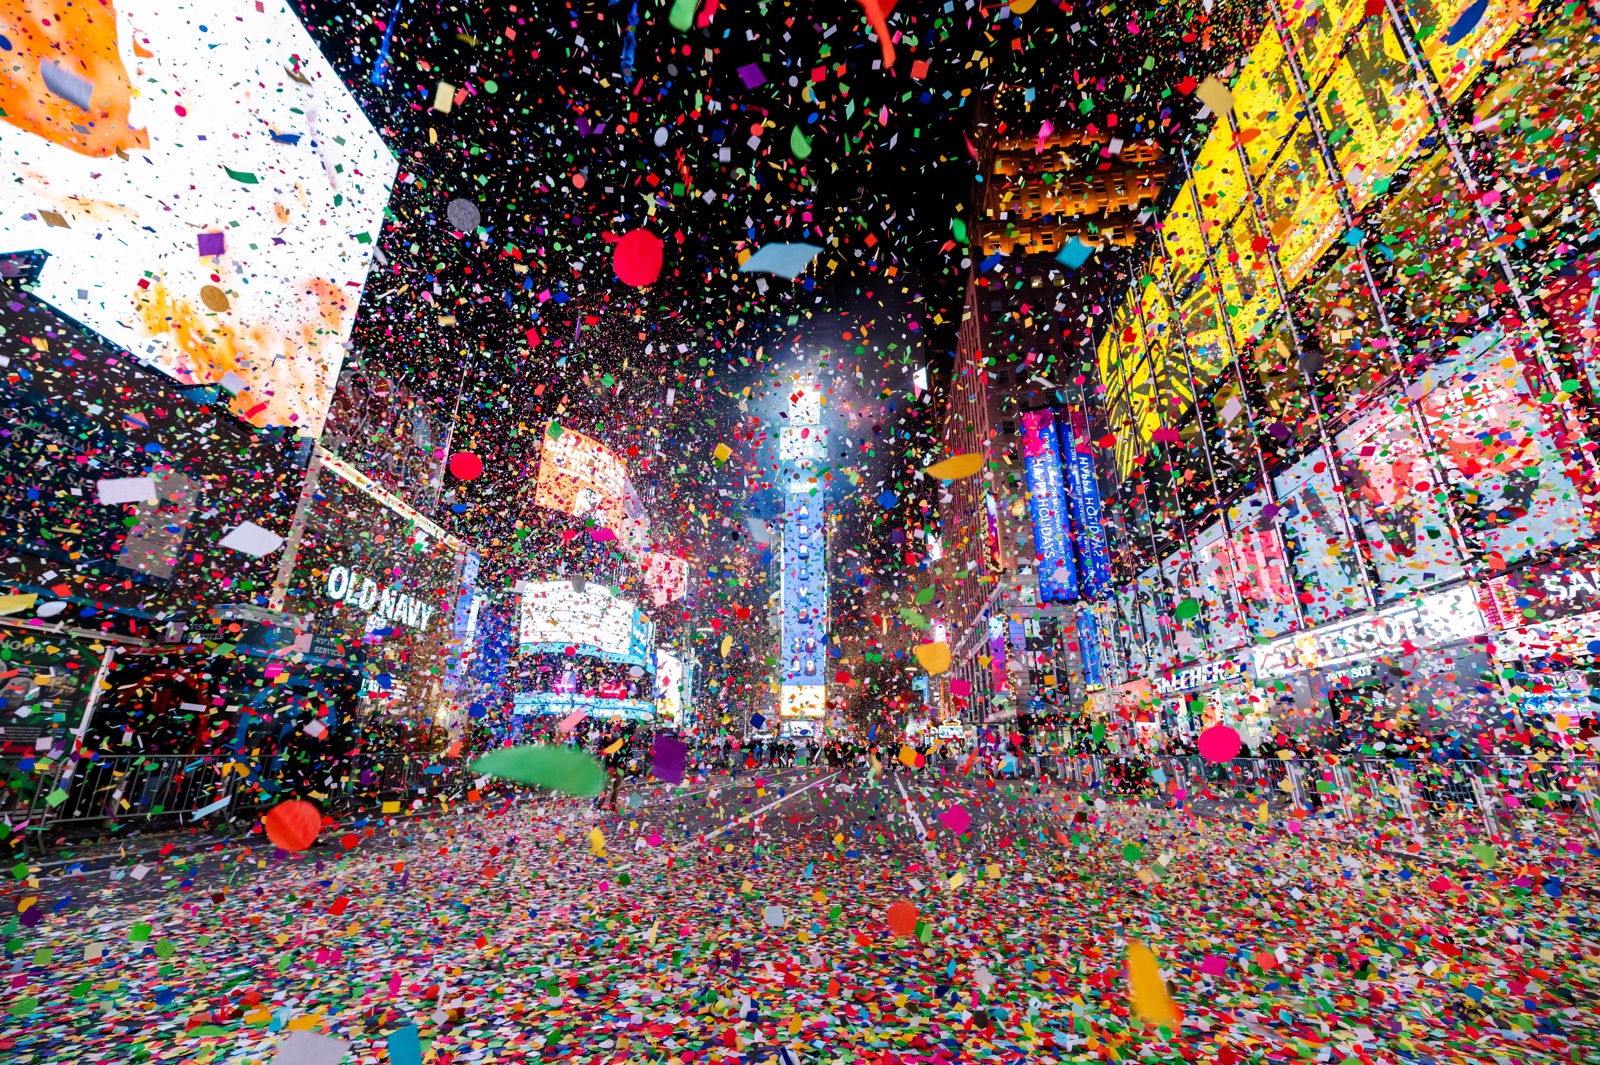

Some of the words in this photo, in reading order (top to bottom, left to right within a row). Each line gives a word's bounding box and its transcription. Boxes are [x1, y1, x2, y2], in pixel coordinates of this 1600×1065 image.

[1033, 458, 1047, 496] HAPPY
[1037, 498, 1055, 559] HOLIDAYS
[328, 566, 377, 610] OLD
[378, 587, 434, 632] NAVY
